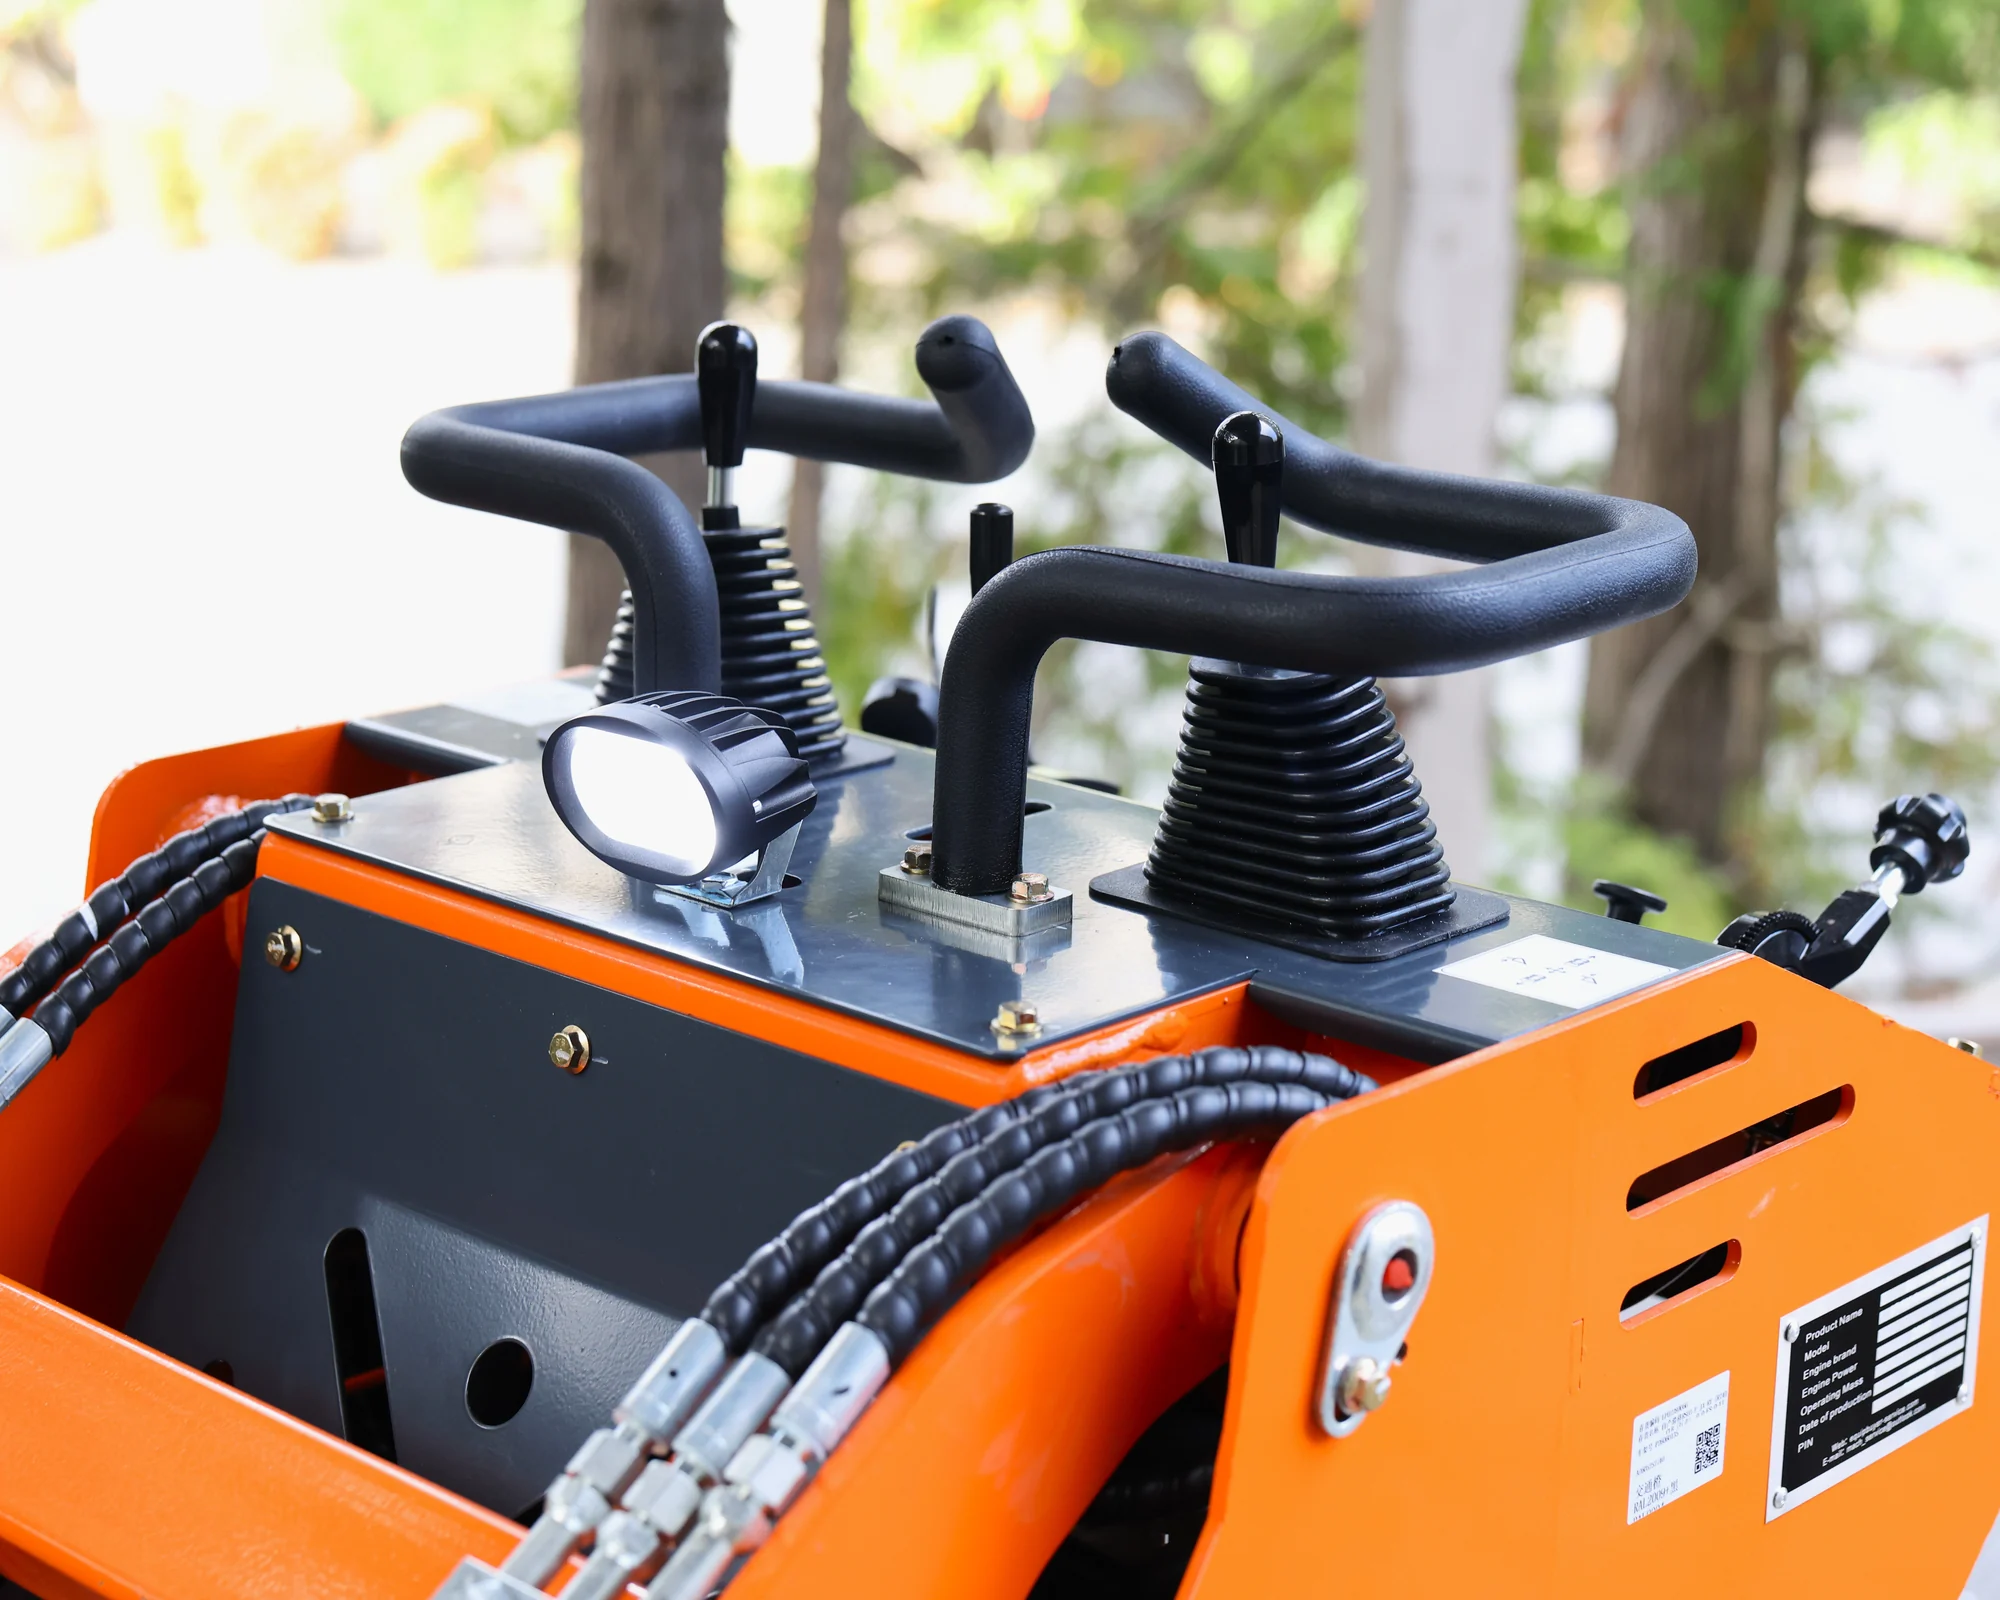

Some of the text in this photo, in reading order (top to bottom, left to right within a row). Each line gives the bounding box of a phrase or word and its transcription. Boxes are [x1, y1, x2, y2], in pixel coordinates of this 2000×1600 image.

[1805, 1308, 1863, 1344] Product Name
[1803, 1343, 1857, 1380] Engine brand
[1804, 1340, 1830, 1362] Model
[1800, 1377, 1864, 1417] Operating Mass
[1801, 1362, 1858, 1399] Engine Power
[1799, 1389, 1872, 1436] Date of production
[1797, 1437, 1814, 1453] PIN
